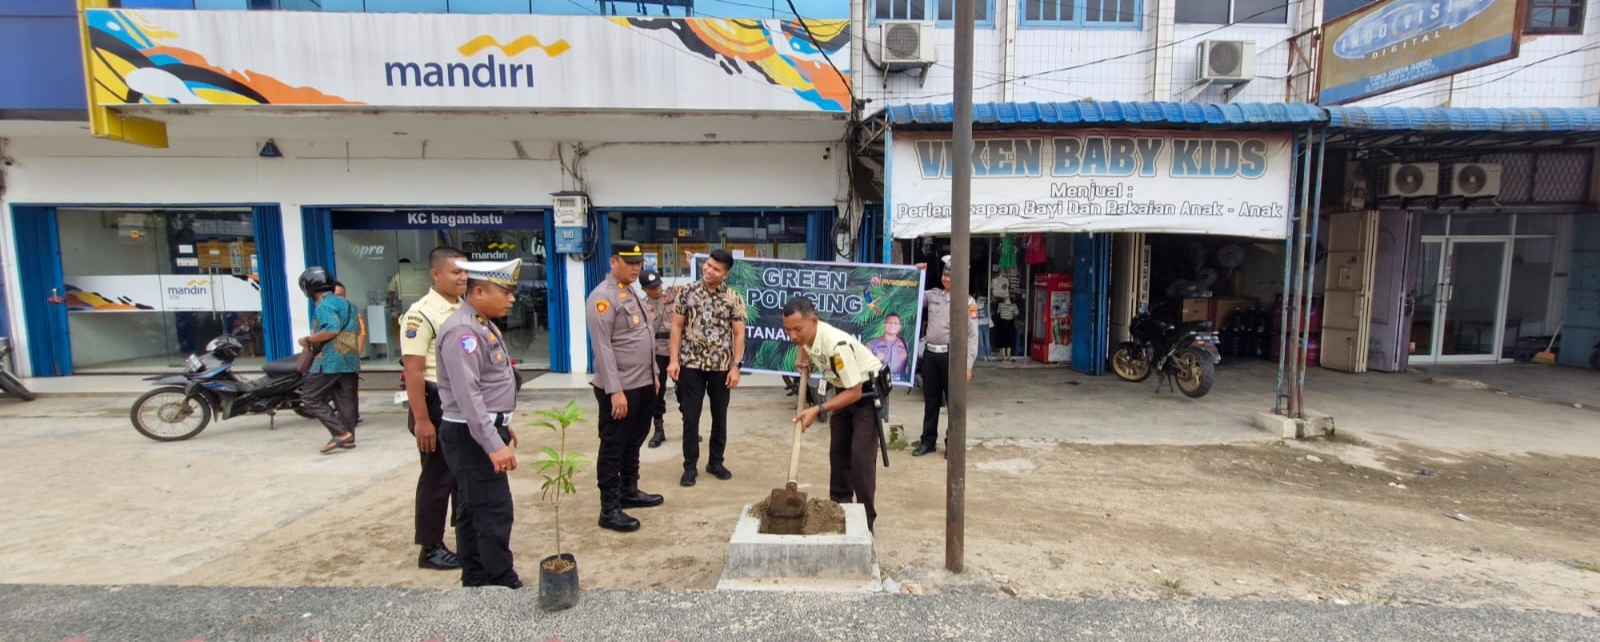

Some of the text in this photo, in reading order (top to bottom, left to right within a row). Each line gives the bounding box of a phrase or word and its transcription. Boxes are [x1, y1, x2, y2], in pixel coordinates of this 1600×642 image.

[1371, 30, 1441, 60] DIGITAL
[385, 54, 534, 88] mandiri
[1051, 136, 1165, 177] BABY
[1169, 137, 1267, 179] KIDS
[1051, 182, 1122, 201] Menjual
[896, 202, 1020, 219] Perlenapan
[1024, 200, 1064, 219] Bayi
[1068, 200, 1101, 215] Dan
[1106, 200, 1175, 215] Pakaian
[1180, 201, 1223, 216] Anak
[1238, 202, 1283, 218] Anak
[407, 213, 503, 227] KC baganbatu
[471, 250, 508, 259] mandiri
[762, 267, 848, 291] GREEN
[168, 285, 207, 295] mandiri
